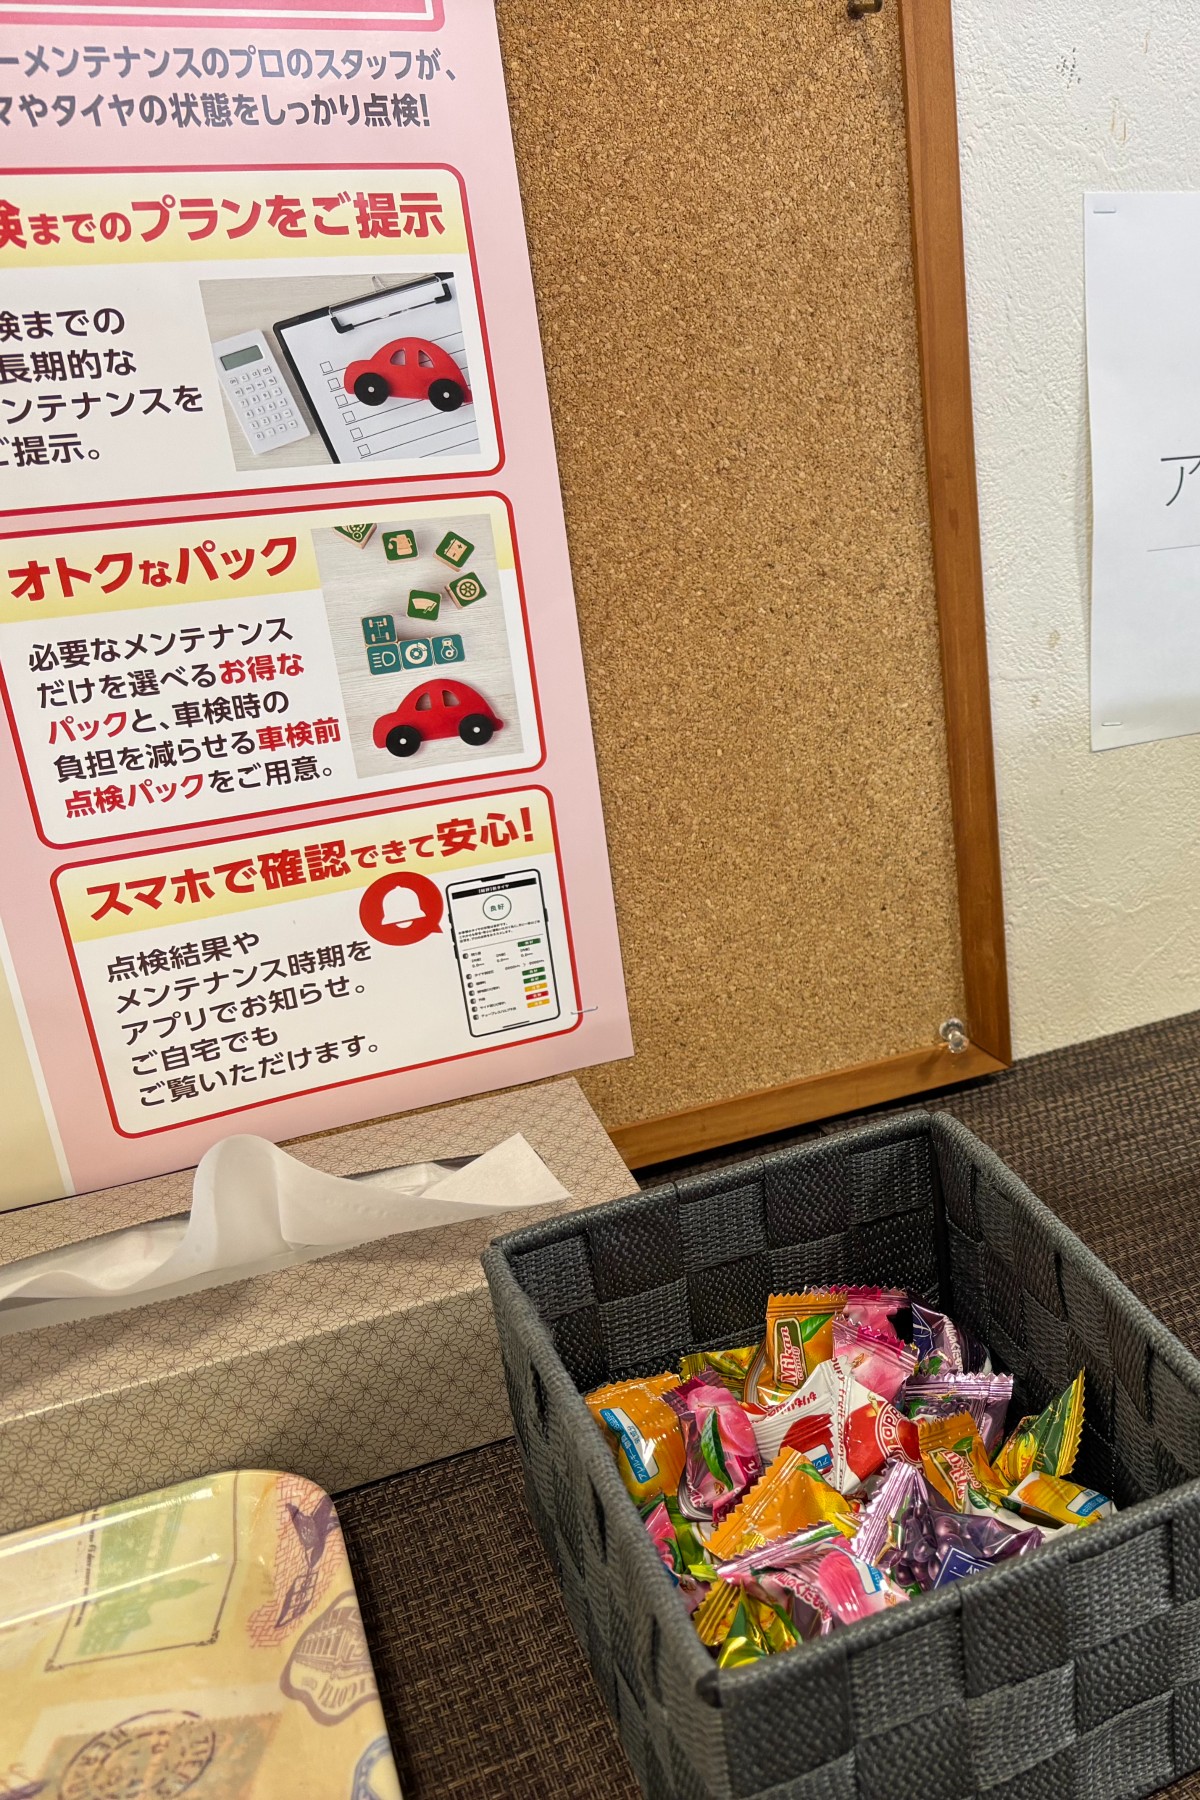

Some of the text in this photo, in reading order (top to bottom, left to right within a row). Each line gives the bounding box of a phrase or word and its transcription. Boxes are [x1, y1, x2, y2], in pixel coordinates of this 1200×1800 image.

[0, 349, 137, 385] 長期的な
[8, 536, 298, 601] オトクなパック
[28, 617, 294, 673] 必要なメンテナンス
[36, 653, 305, 709] だけを選べるお得な
[47, 694, 290, 745] パックと、車検時の
[52, 717, 341, 783] 負担を減らせる車検前
[65, 756, 333, 819] 点検パックをご用意。
[86, 807, 535, 921] スマホで確認できて安心!
[106, 931, 260, 984] 点検結果や
[116, 940, 372, 1014] メンテナンス時期を
[121, 981, 366, 1046] アプリでお知らせ。
[131, 1026, 278, 1076] ご自宅でも
[139, 1032, 380, 1109] ご覧いただけます。
[780, 1326, 798, 1386] Mikan
